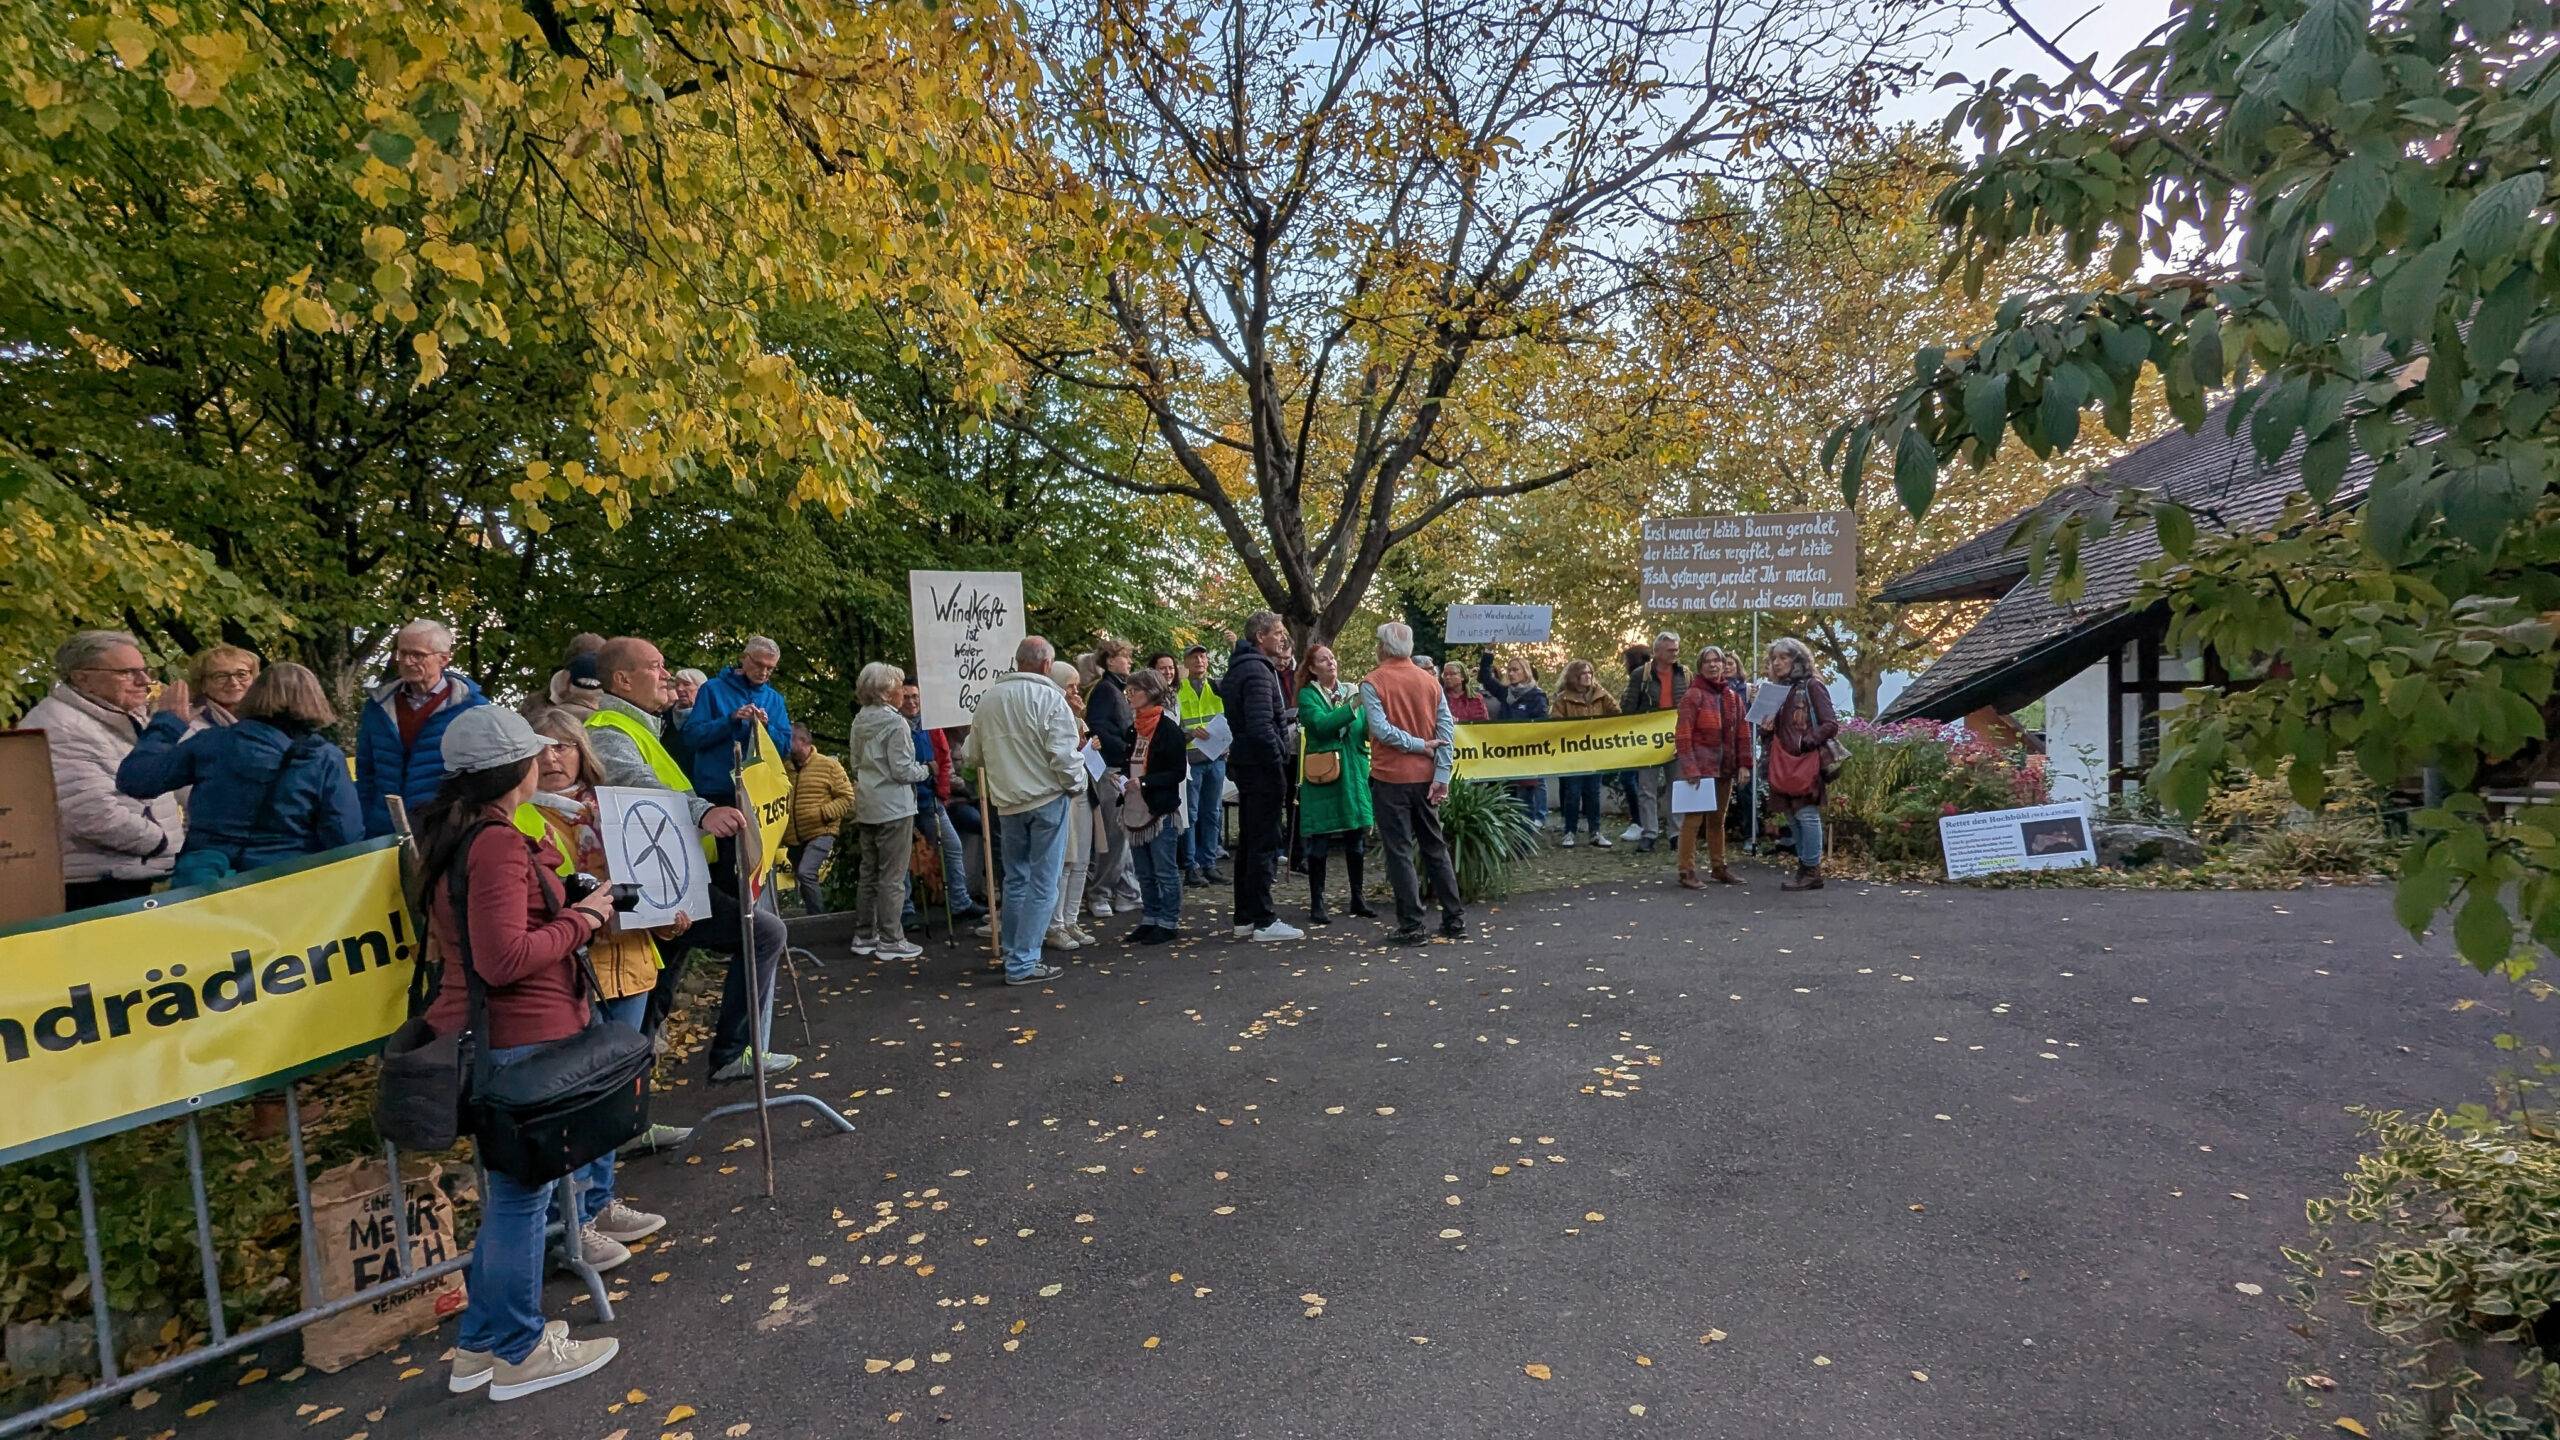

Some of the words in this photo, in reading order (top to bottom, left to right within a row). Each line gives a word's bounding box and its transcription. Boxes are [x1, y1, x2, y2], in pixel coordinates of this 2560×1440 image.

[1644, 522, 1666, 540] Erst
[1669, 527, 1693, 540] wenn
[1694, 521, 1711, 539] der
[1713, 520, 1740, 538] letzte
[1745, 518, 1783, 537] Baum
[1786, 515, 1840, 540] gerodet,
[1643, 545, 1661, 560] der
[1663, 544, 1690, 560] letzte
[1692, 541, 1721, 560] Fluss
[1725, 541, 1775, 565] vergiftet,
[1777, 543, 1796, 557] der
[1800, 538, 1833, 556] letzte
[1642, 566, 1670, 585] Fisch
[1721, 566, 1758, 584] werdet
[1760, 565, 1781, 583] Ihr
[1647, 589, 1679, 609] dass
[1682, 597, 1707, 609] man
[1709, 590, 1737, 609] Geld
[1743, 588, 1773, 608] nicht
[1773, 594, 1806, 607] essen
[965, 624, 980, 642] ist
[959, 683, 986, 713] log
[1482, 739, 1556, 759] kommt,
[1560, 730, 1647, 753] Industrie
[0, 911, 410, 1063] ndrädern!
[353, 1232, 446, 1292] FAH
